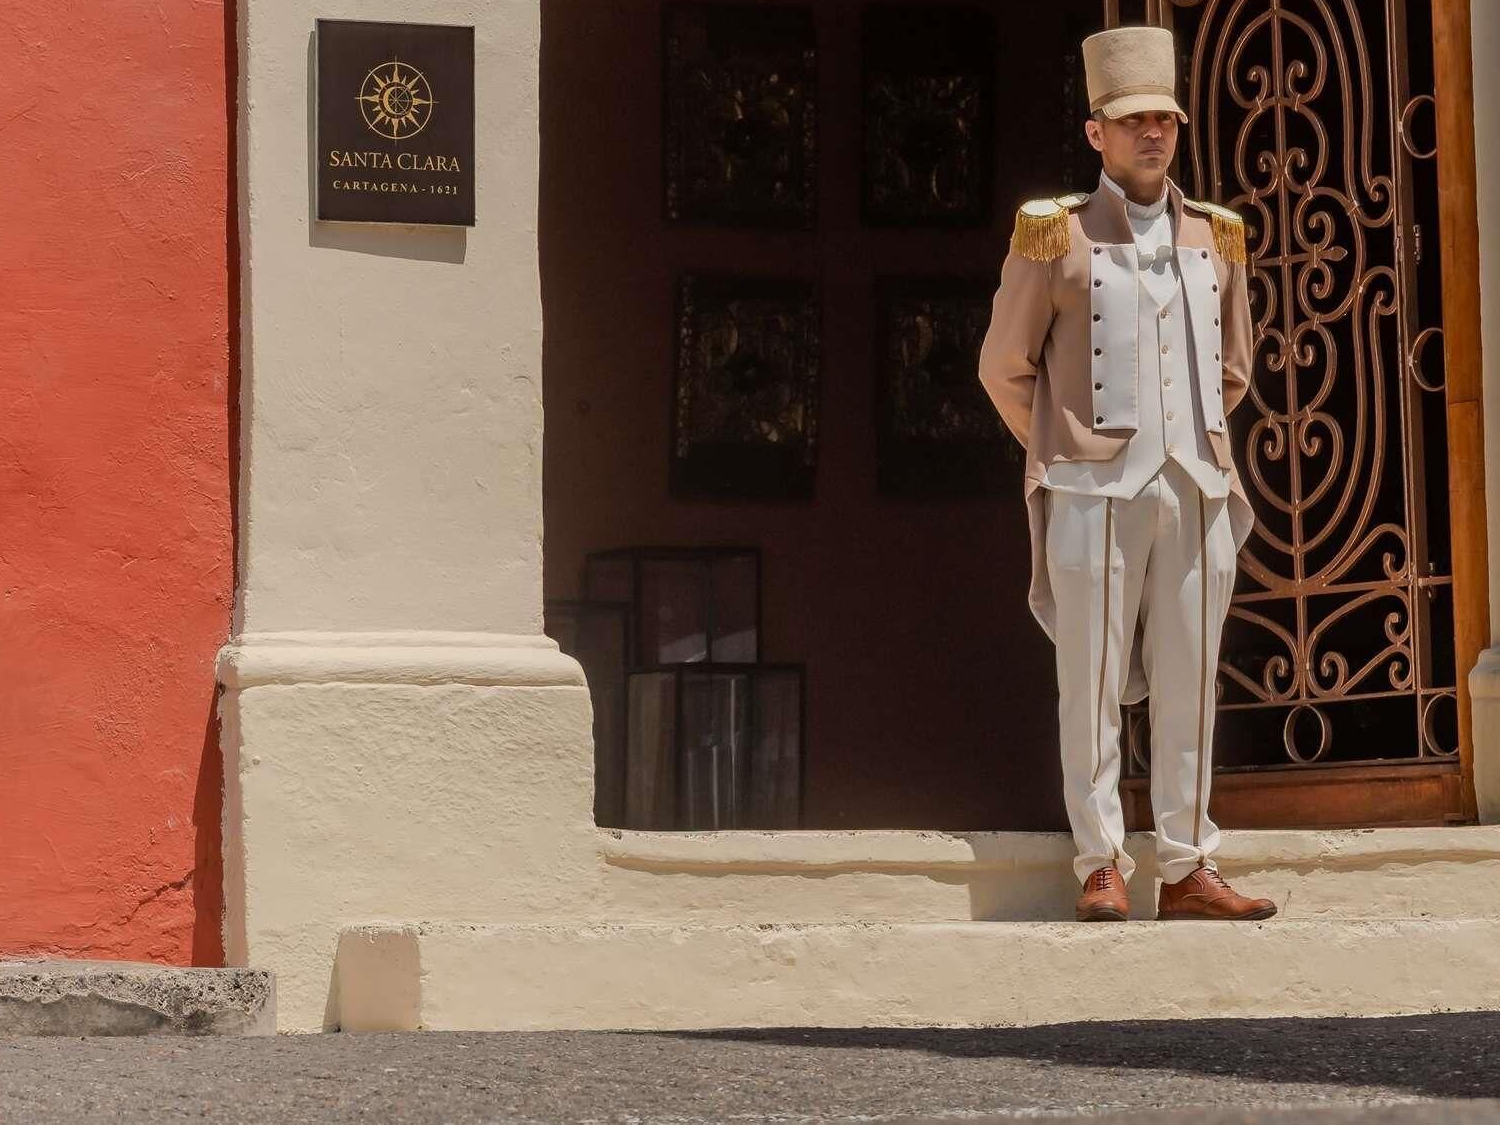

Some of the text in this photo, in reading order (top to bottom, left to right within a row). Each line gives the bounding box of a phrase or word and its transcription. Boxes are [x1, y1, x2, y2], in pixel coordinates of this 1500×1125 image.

[329, 150, 461, 172] SANTA CLARA
[332, 180, 418, 194] CARTAGENA
[430, 185, 458, 195] 1621
